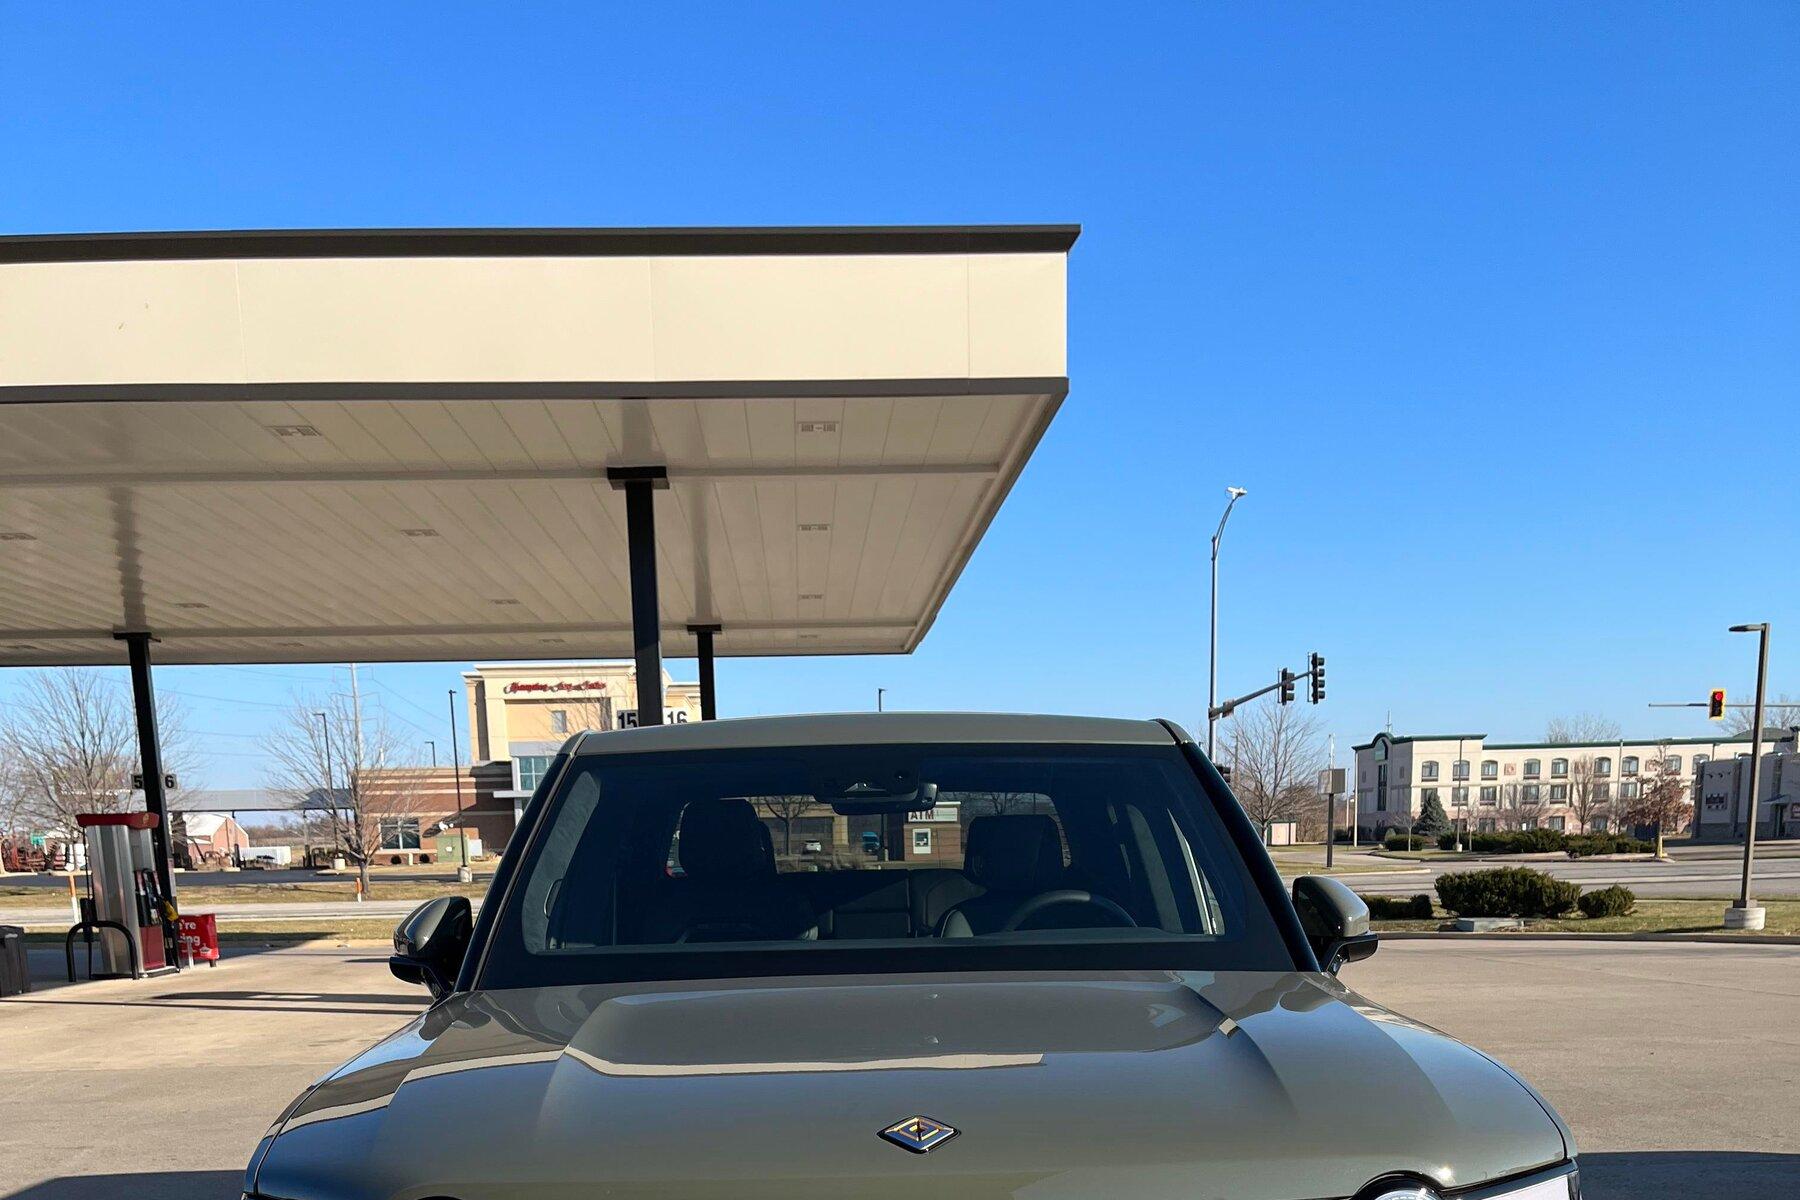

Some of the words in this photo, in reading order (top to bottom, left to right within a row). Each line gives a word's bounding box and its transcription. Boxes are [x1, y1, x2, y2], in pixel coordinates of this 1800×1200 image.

[618, 712, 638, 729] 15
[667, 710, 688, 724] 16
[133, 775, 143, 789] 5
[164, 774, 175, 789] 6
[910, 811, 934, 820] ATM
